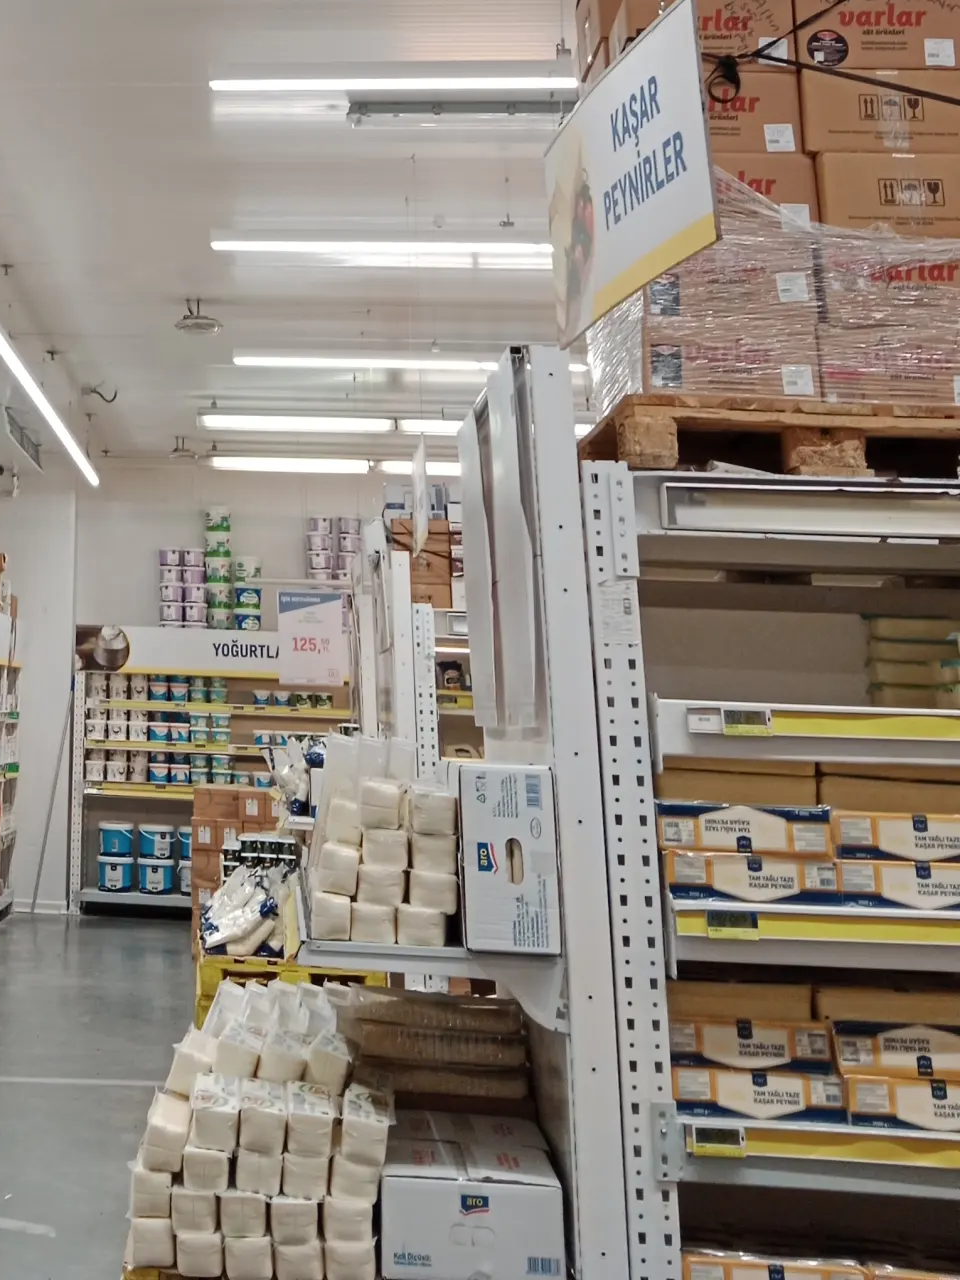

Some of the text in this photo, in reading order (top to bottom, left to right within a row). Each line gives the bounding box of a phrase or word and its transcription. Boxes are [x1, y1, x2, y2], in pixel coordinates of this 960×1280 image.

[698, 8, 754, 32] rlar
[838, 3, 927, 28] varlar
[708, 88, 761, 113] rlar
[610, 75, 661, 153] KAŞAR
[603, 130, 688, 232] PEYNİRLER
[479, 847, 488, 867] aro
[748, 874, 761, 882] TAM
[947, 1102, 960, 1110] YAĞ
[466, 1197, 484, 1207] aro
